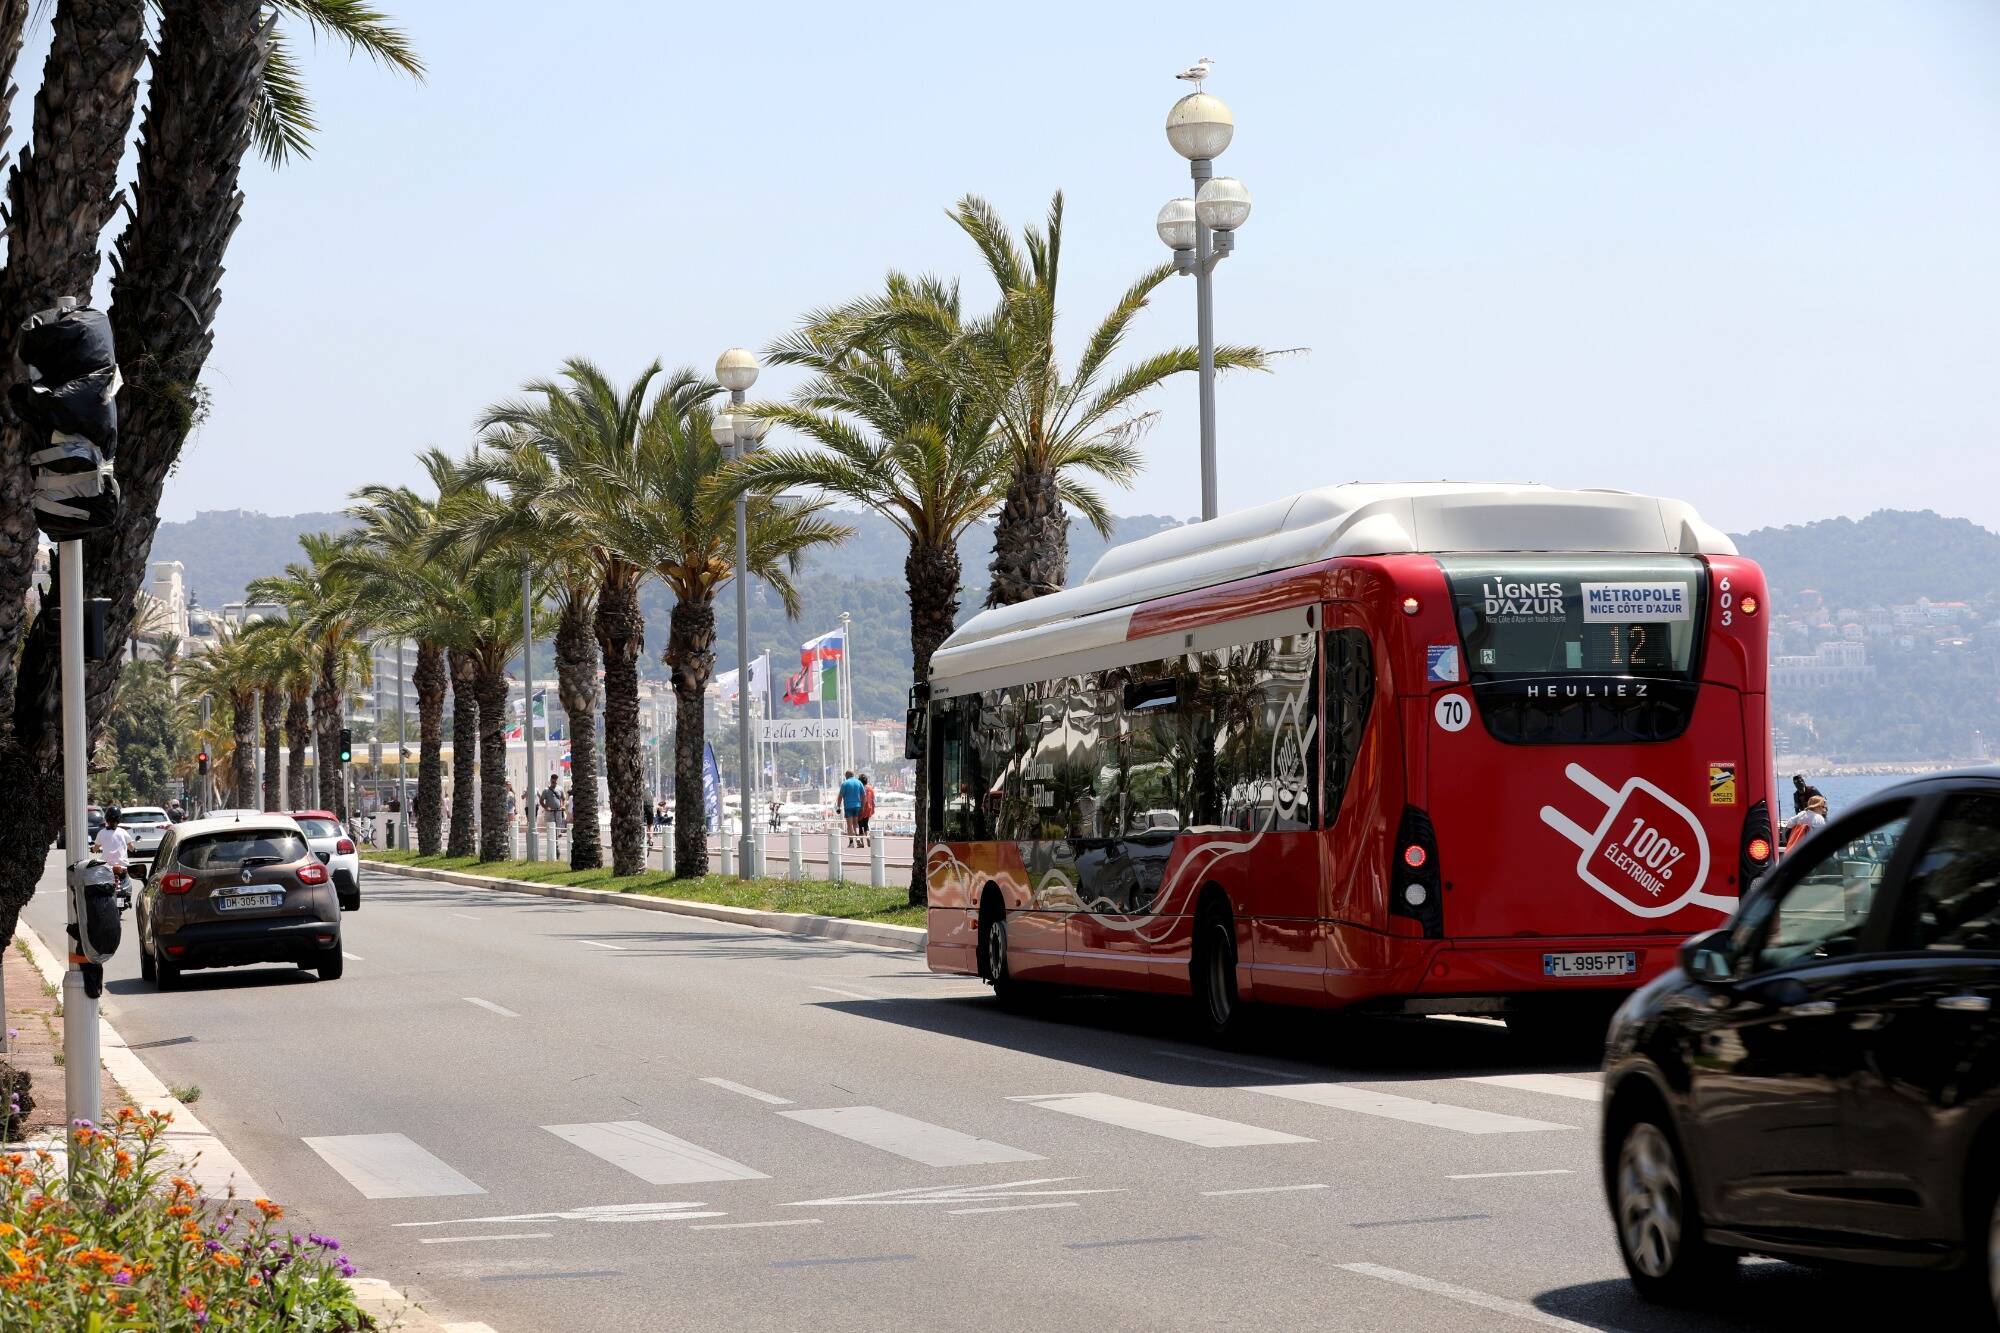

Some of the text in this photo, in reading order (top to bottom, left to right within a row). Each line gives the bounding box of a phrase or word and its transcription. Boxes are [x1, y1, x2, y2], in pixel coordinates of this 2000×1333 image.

[1483, 577, 1564, 598] LIGNES
[1589, 586, 1681, 602] MÉTROPOLE
[1485, 599, 1567, 615] D'AZUR
[1590, 602, 1682, 614] NICE CÔTE D'AZUR
[1611, 626, 1647, 664] 12
[1527, 684, 1648, 697] HEULIEZ
[1443, 701, 1463, 724] 70
[1622, 817, 1686, 880] 100%
[1604, 842, 1665, 897] ÉLECTRIQUE
[1552, 955, 1625, 971] FL-995-PT
